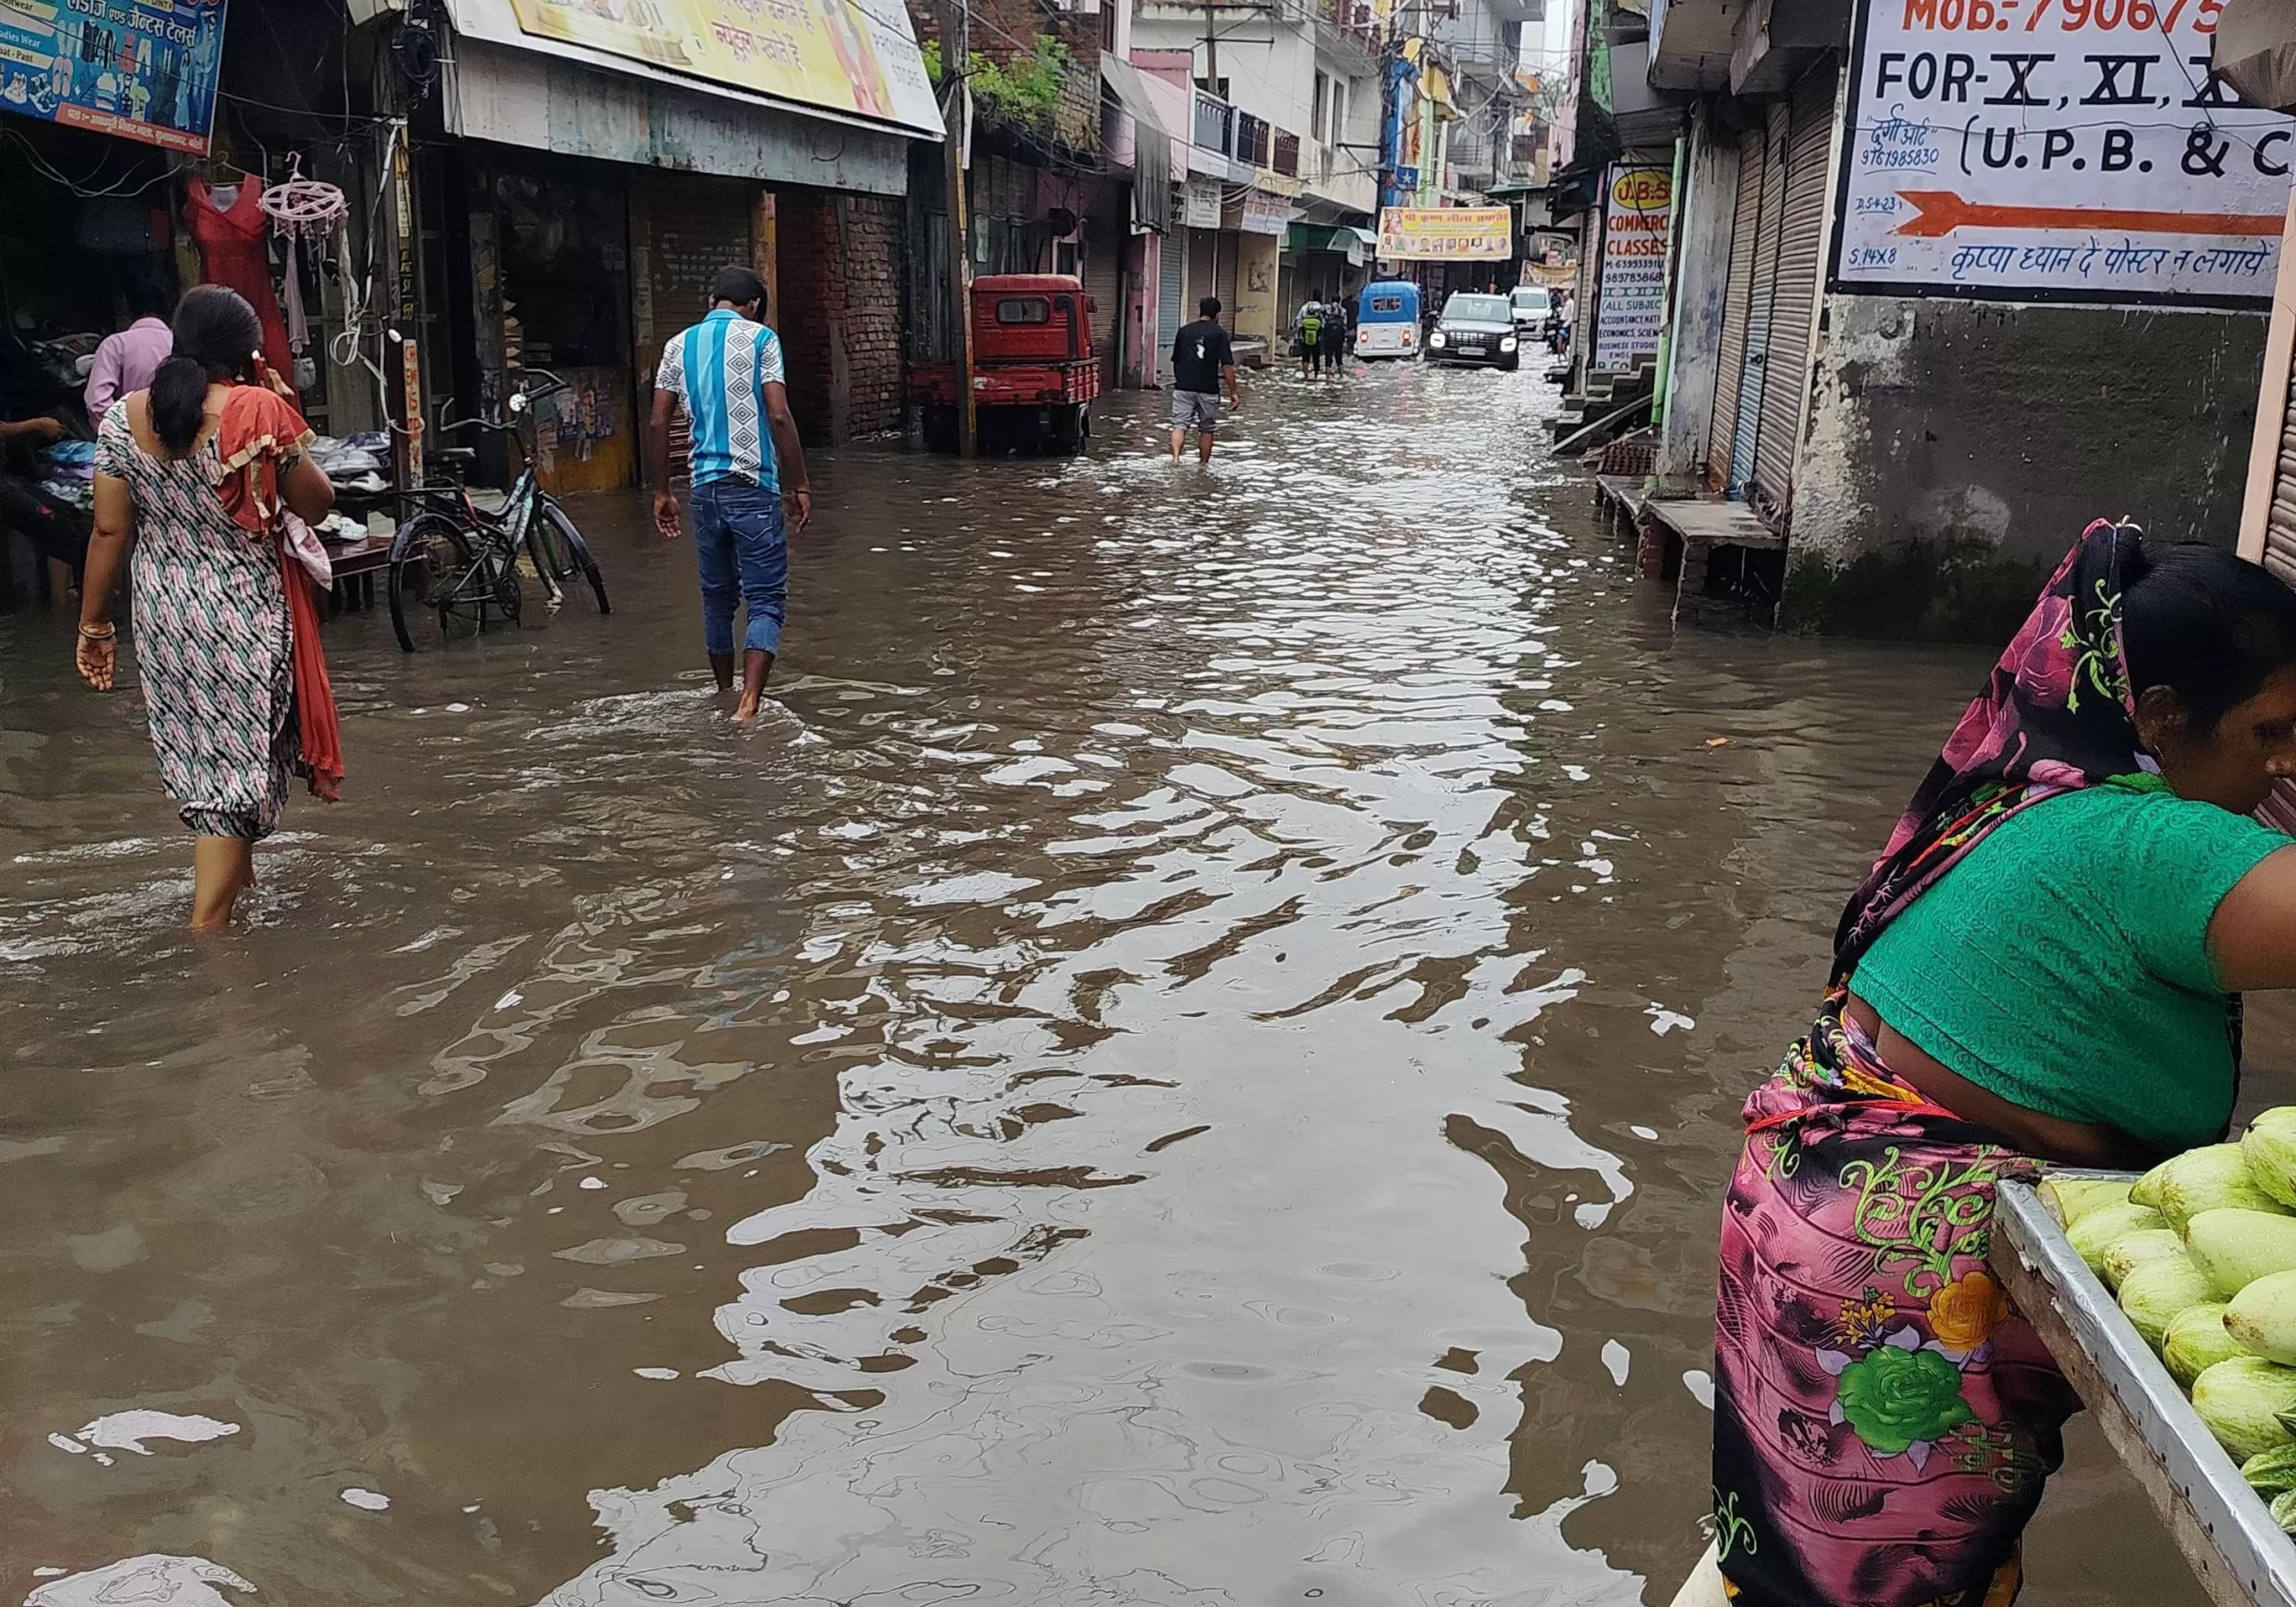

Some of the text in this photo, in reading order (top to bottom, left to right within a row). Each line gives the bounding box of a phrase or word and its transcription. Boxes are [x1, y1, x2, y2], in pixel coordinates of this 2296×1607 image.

[0, 30, 20, 43] adies
[2181, 127, 2231, 178] &
[1608, 214, 1669, 231] COMMERC
[1607, 239, 1666, 256] CLASSES
[2104, 238, 2171, 274] पोस्टर
[2173, 250, 2194, 272] न
[1626, 300, 1662, 310] SUBJEC
[1637, 328, 1659, 337] SCIEN
